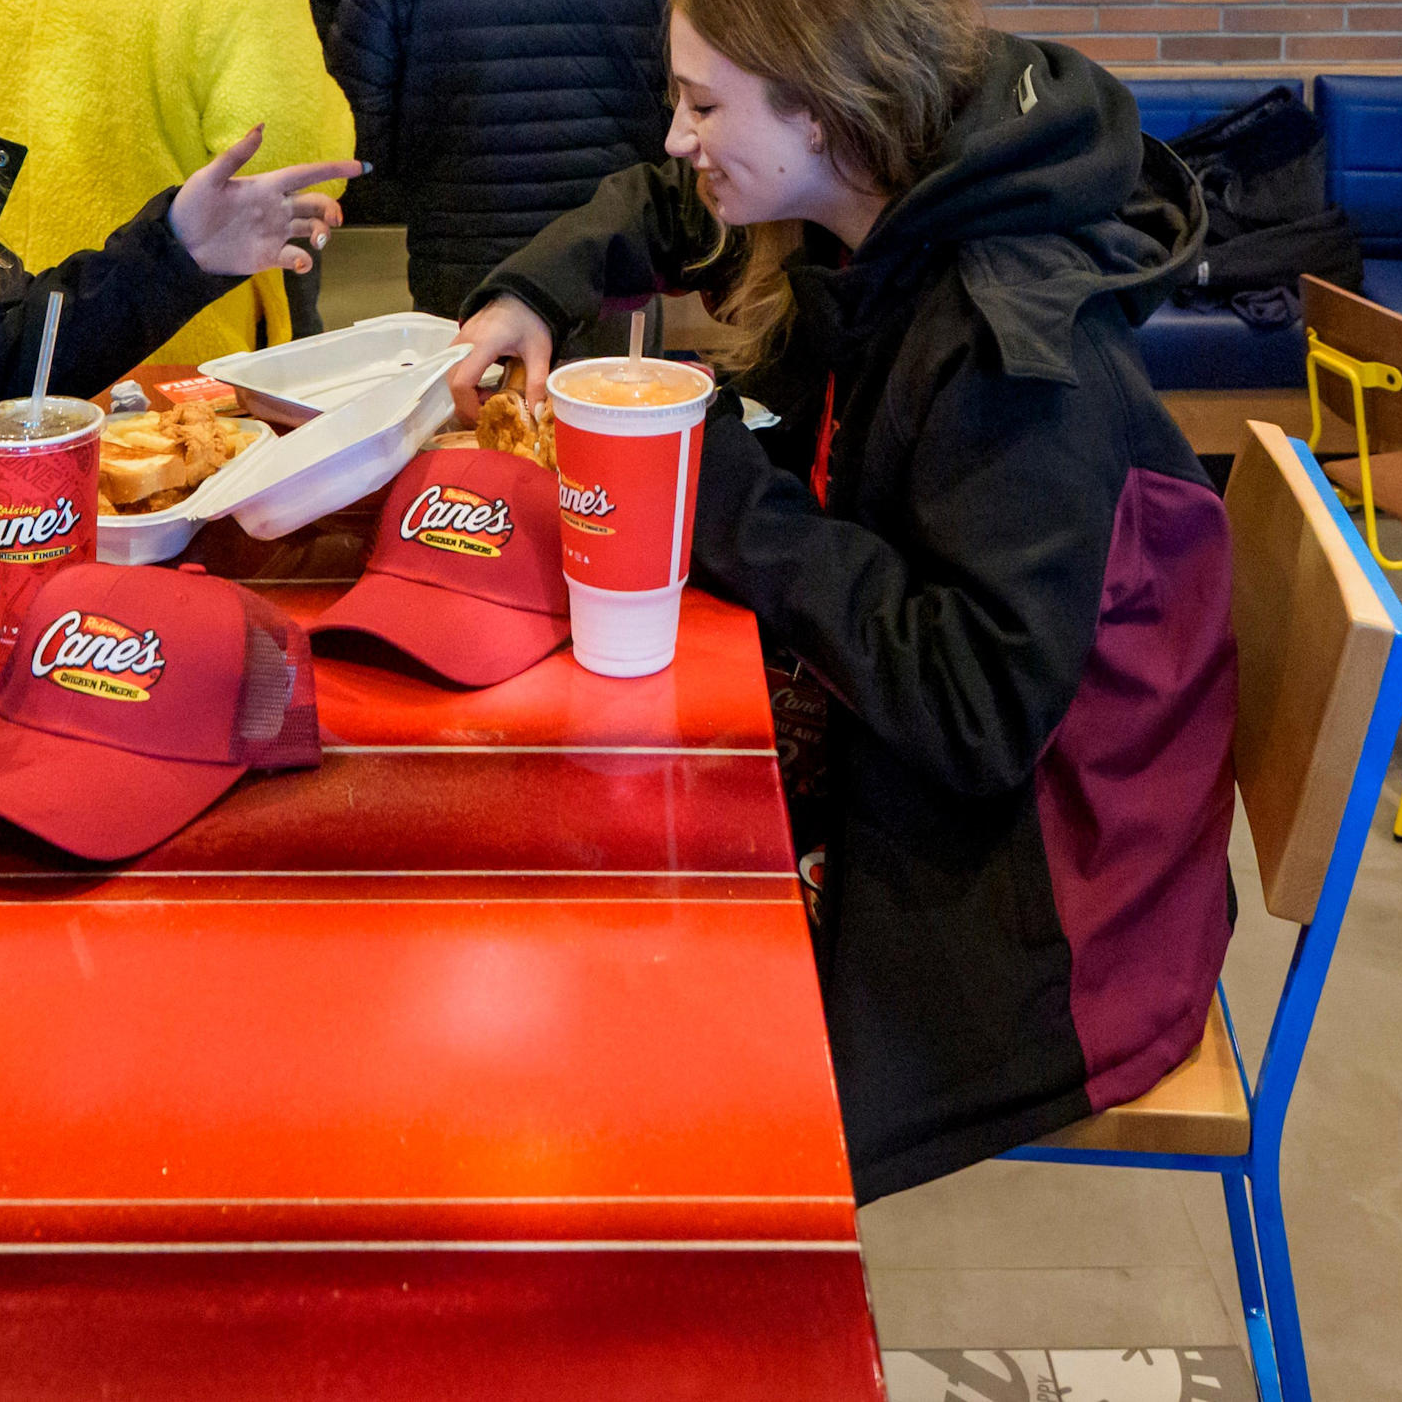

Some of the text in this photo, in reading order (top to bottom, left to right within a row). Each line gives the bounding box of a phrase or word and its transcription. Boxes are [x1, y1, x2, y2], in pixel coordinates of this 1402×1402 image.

[401, 484, 514, 539] Cane's
[558, 483, 616, 517] ane's
[425, 533, 493, 555] CHICKEN FINGERS
[83, 616, 128, 638] Raising
[31, 609, 166, 678] Cane's
[59, 671, 140, 699] CHICKEN FINGERS
